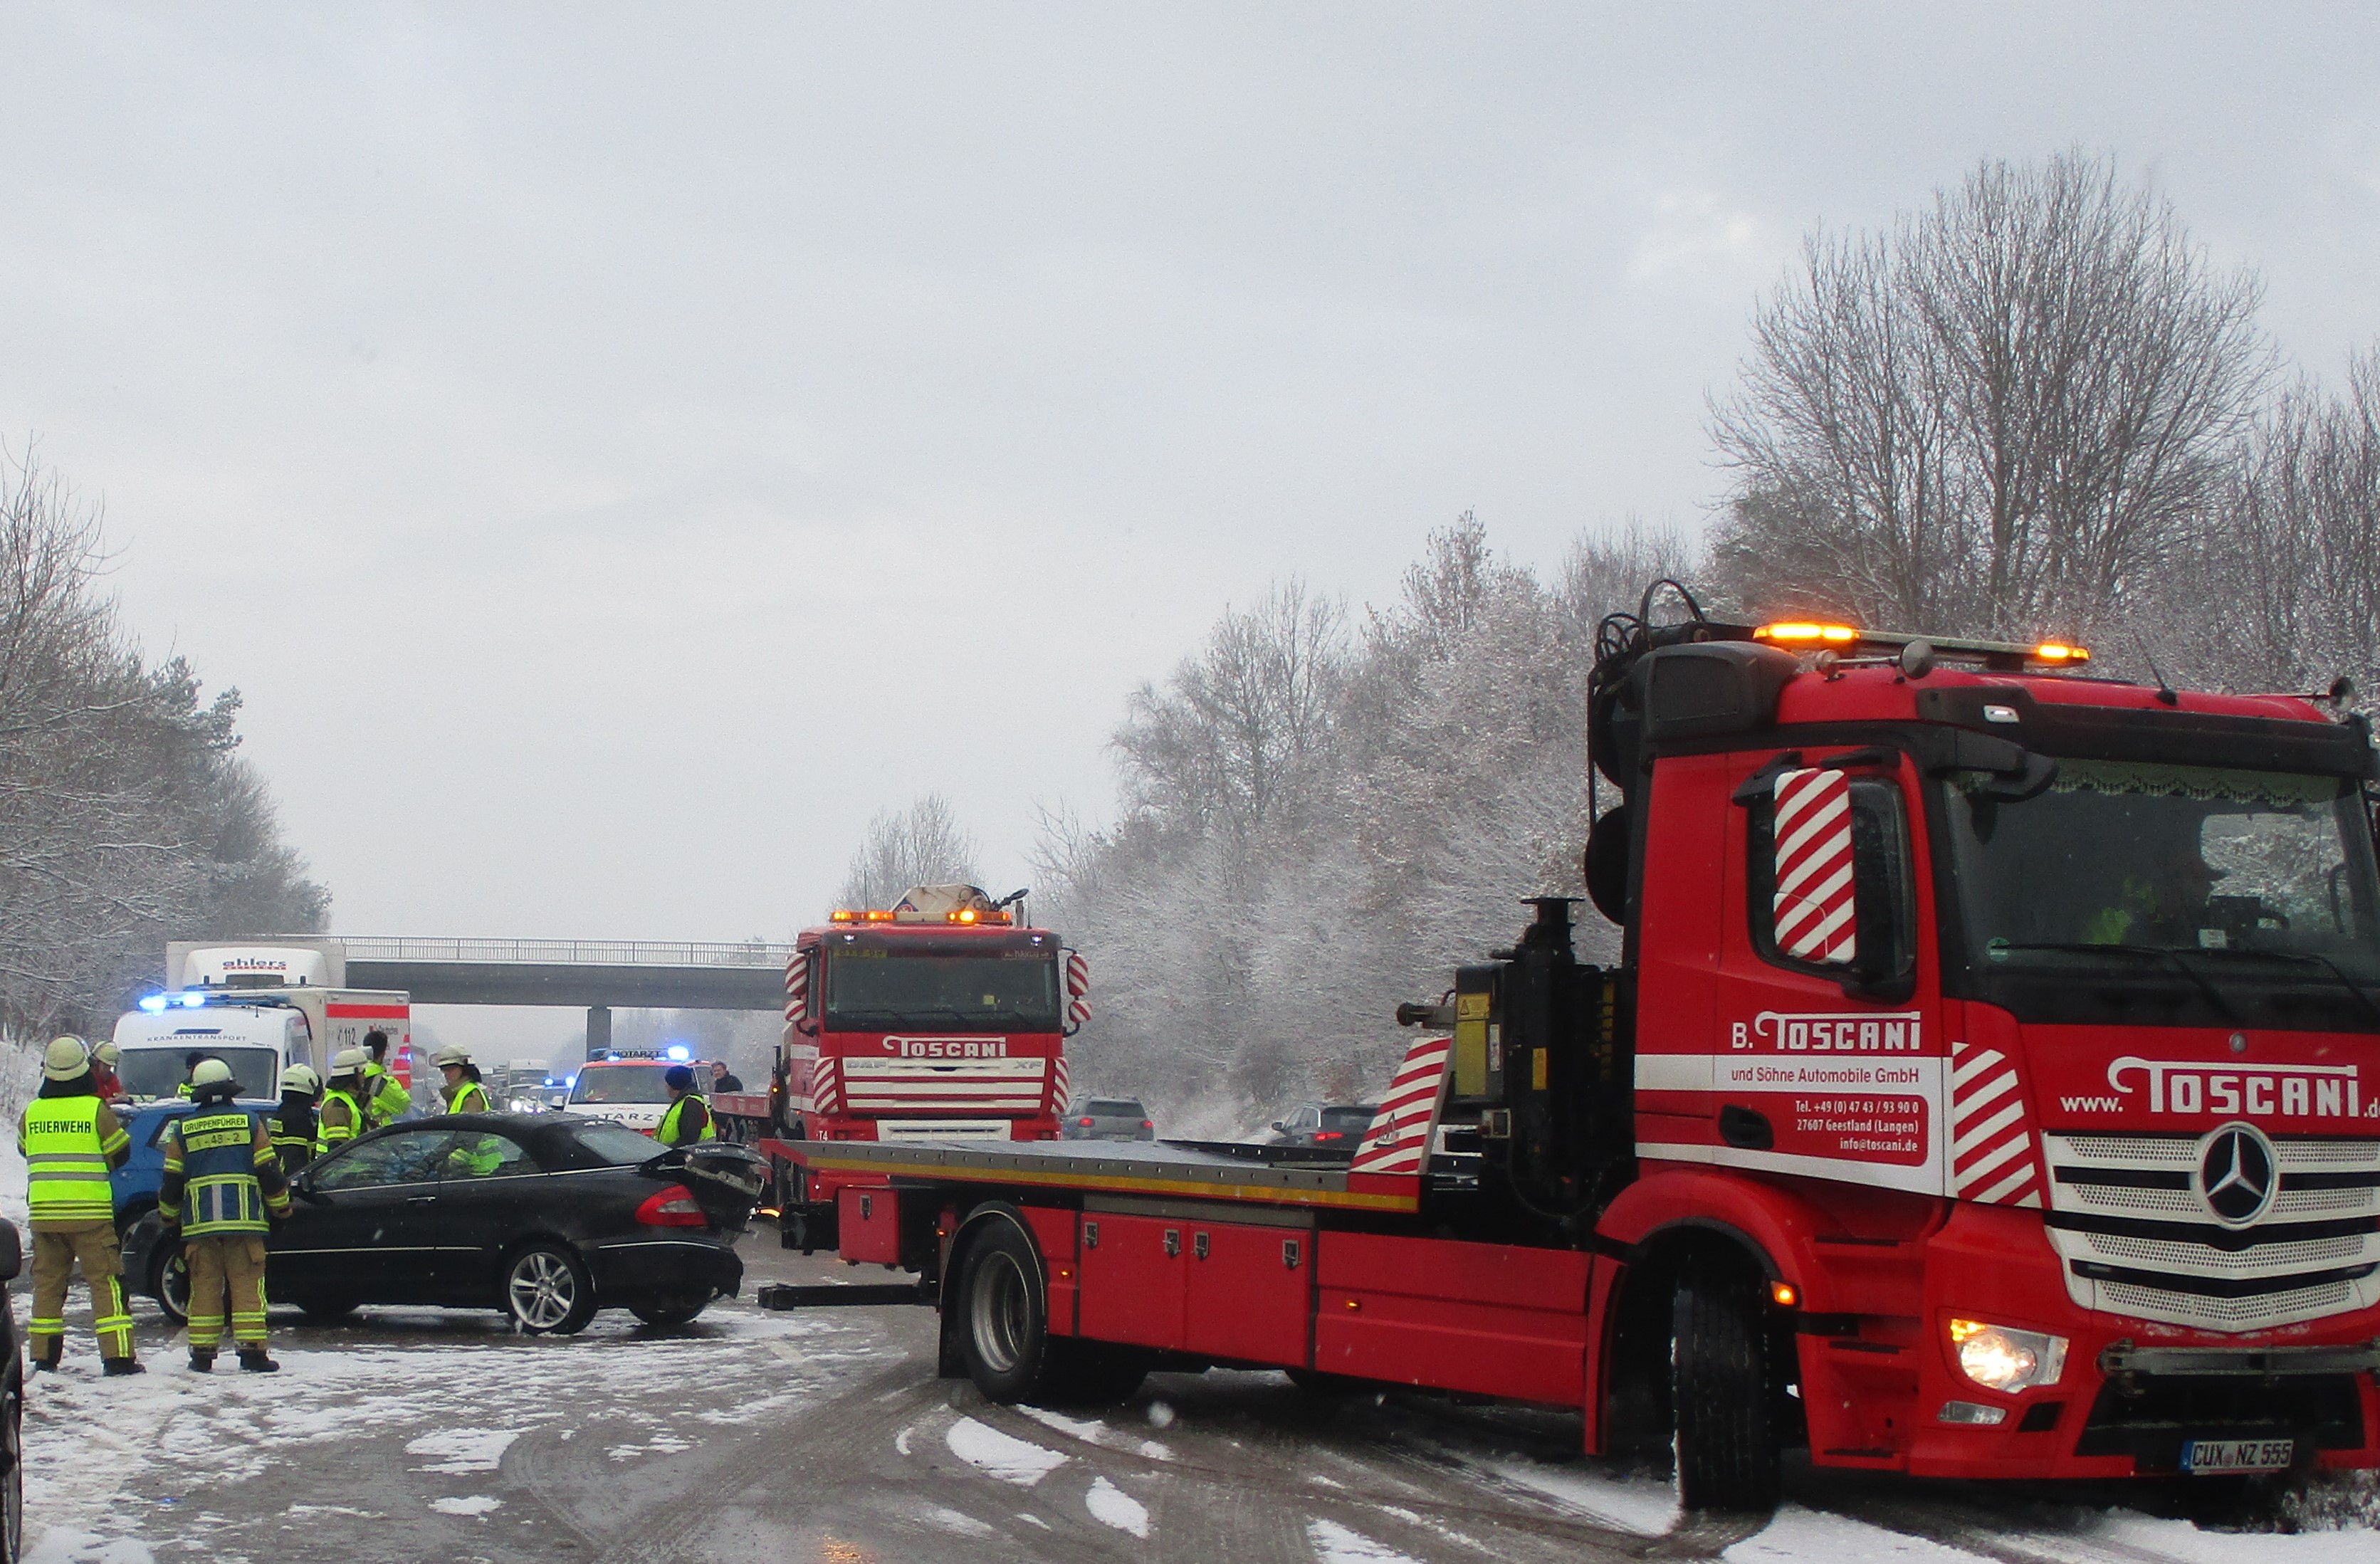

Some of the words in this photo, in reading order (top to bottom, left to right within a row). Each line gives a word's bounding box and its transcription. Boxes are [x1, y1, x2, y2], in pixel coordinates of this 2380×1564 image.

[222, 957, 287, 967] ahlers
[344, 1027, 356, 1045] 112
[1731, 1022, 1753, 1049] B.
[1754, 1011, 1922, 1050] TOSCANI
[882, 1035, 1007, 1057] TOSCANI
[612, 1050, 661, 1059] NOTARZT
[1731, 1067, 1753, 1081] und
[1756, 1067, 1795, 1082] Söhne
[1798, 1067, 1872, 1083] Automobile
[1875, 1068, 1919, 1083] GmbH
[1796, 1100, 1811, 1112] Tel.
[1814, 1101, 1832, 1113] +49
[1834, 1101, 1847, 1115] (0)
[1849, 1101, 1860, 1113] 47
[1862, 1101, 1874, 1113] 43
[1883, 1102, 1894, 1113] 93
[1897, 1102, 1909, 1113] 90
[1912, 1102, 1919, 1113] 0
[29, 1120, 91, 1135] FEUERWEHR
[184, 1117, 246, 1133] GRUPPENFÜHRER
[1797, 1118, 1824, 1131] 27607
[1826, 1118, 1872, 1131] Geestland
[1875, 1119, 1919, 1135] (Langen)
[818, 1130, 828, 1140] T4
[1840, 1137, 1918, 1152] info@toscani.de
[2193, 1444, 2224, 1466] CUX
[2235, 1444, 2258, 1465] NZ
[2260, 1443, 2292, 1464] 555
